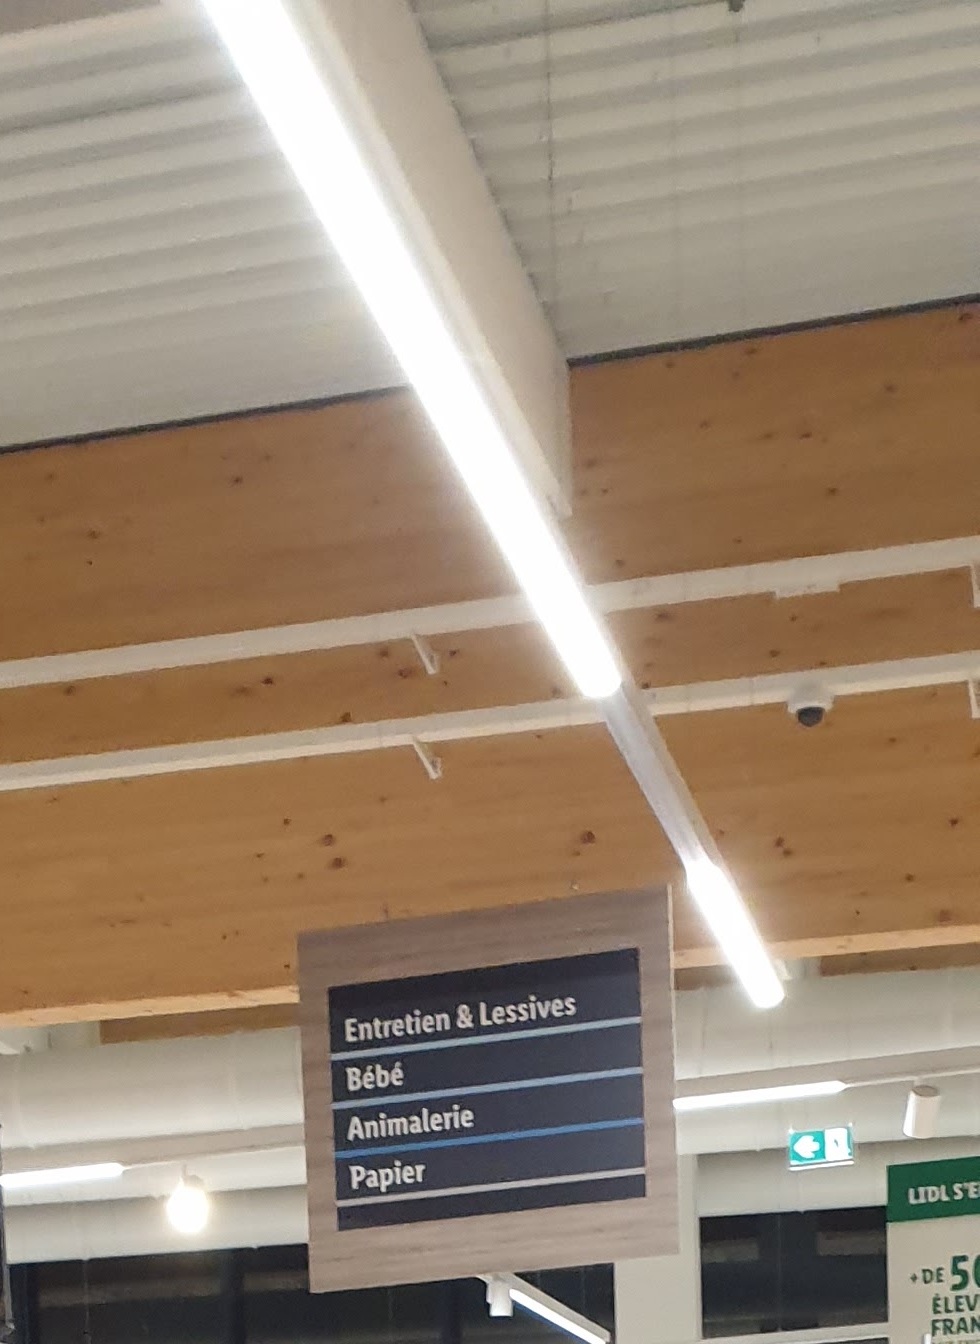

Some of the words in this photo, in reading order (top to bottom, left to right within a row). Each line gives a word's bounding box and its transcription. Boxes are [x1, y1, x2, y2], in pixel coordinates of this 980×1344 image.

[345, 1009, 451, 1043] Entretien
[456, 1004, 474, 1030] &
[479, 995, 577, 1026] Lessives
[345, 1061, 404, 1092] Bébé
[347, 1104, 475, 1142] Animalerie
[349, 1160, 426, 1192] Papier
[908, 1184, 950, 1205] LIDL
[922, 1267, 945, 1284] DE
